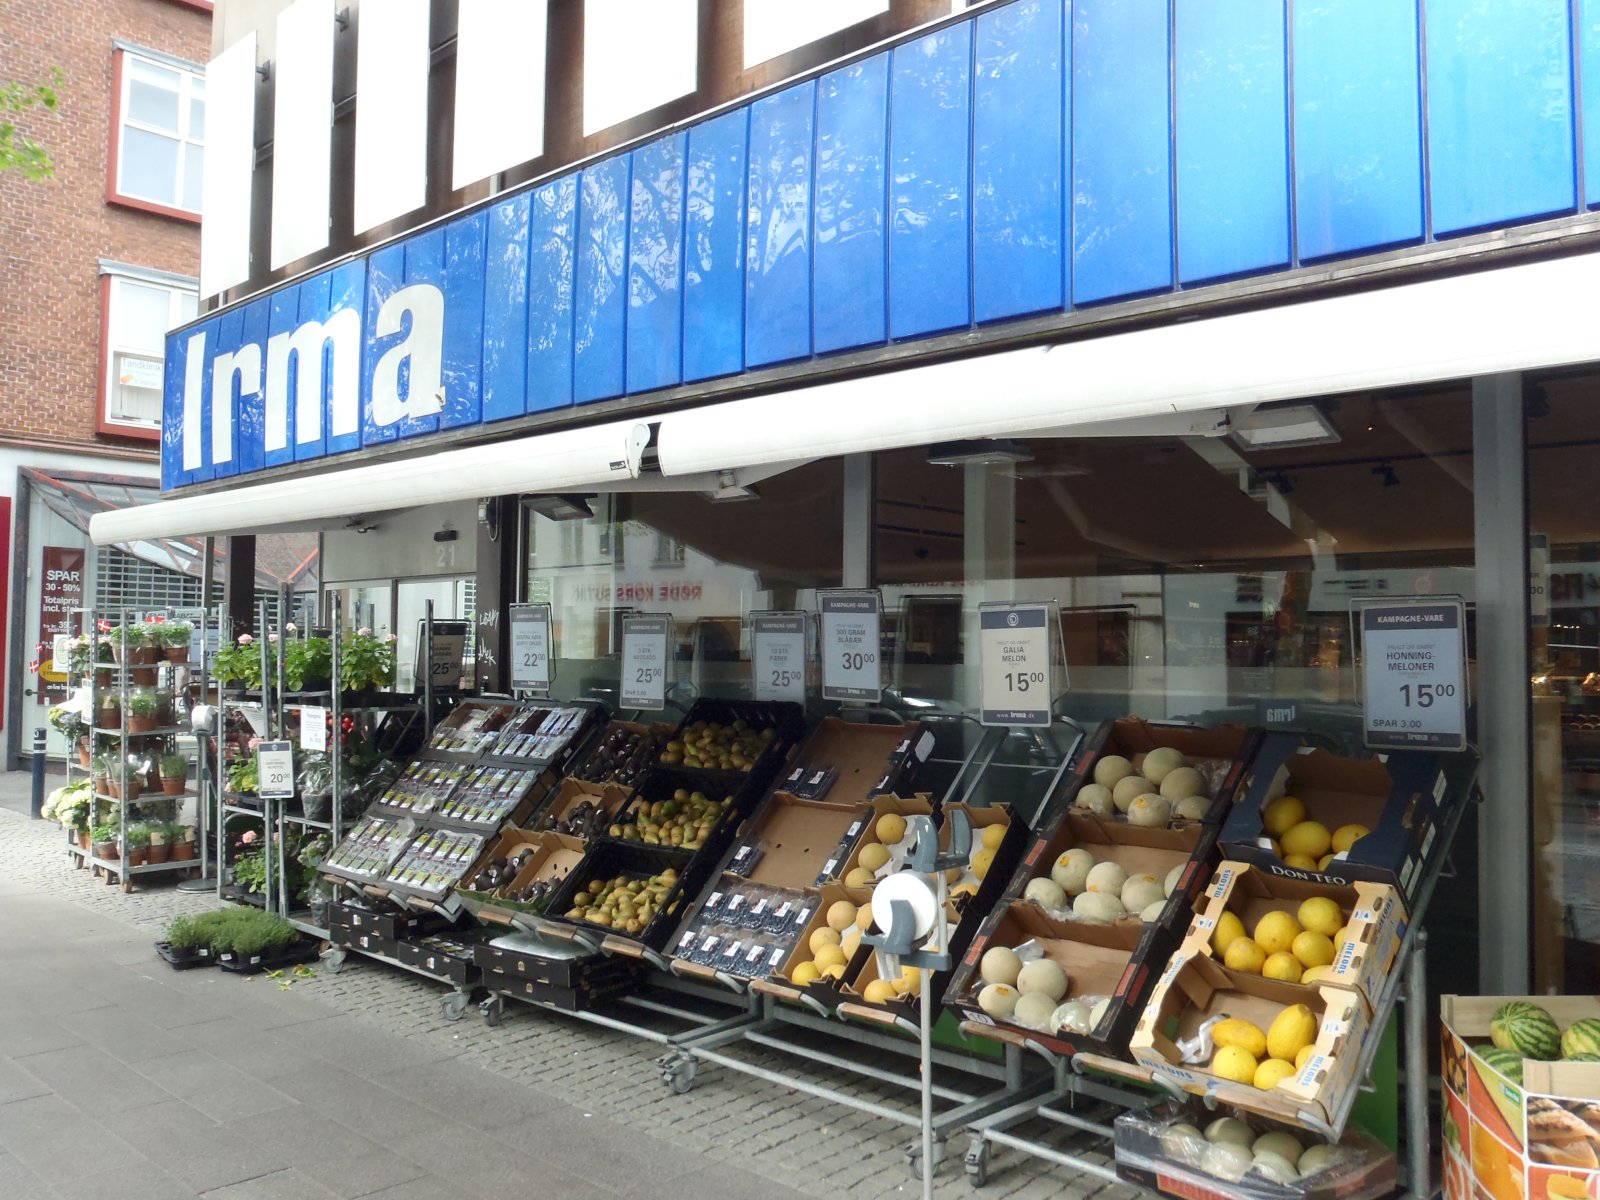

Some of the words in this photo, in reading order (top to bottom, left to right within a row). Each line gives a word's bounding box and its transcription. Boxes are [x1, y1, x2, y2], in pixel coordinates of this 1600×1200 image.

[183, 283, 445, 471] Irma
[436, 545, 456, 567] 21
[46, 570, 80, 581] SPAR
[43, 596, 79, 605] Totalpris
[1377, 614, 1444, 623] KAMPAGNE-VARE
[1003, 646, 1025, 654] GALIA
[1386, 651, 1436, 660] HONNING-
[1388, 662, 1435, 671] MELONER
[1372, 719, 1398, 727] SPAR
[1270, 865, 1309, 880] DON
[1311, 873, 1347, 886] TEO
